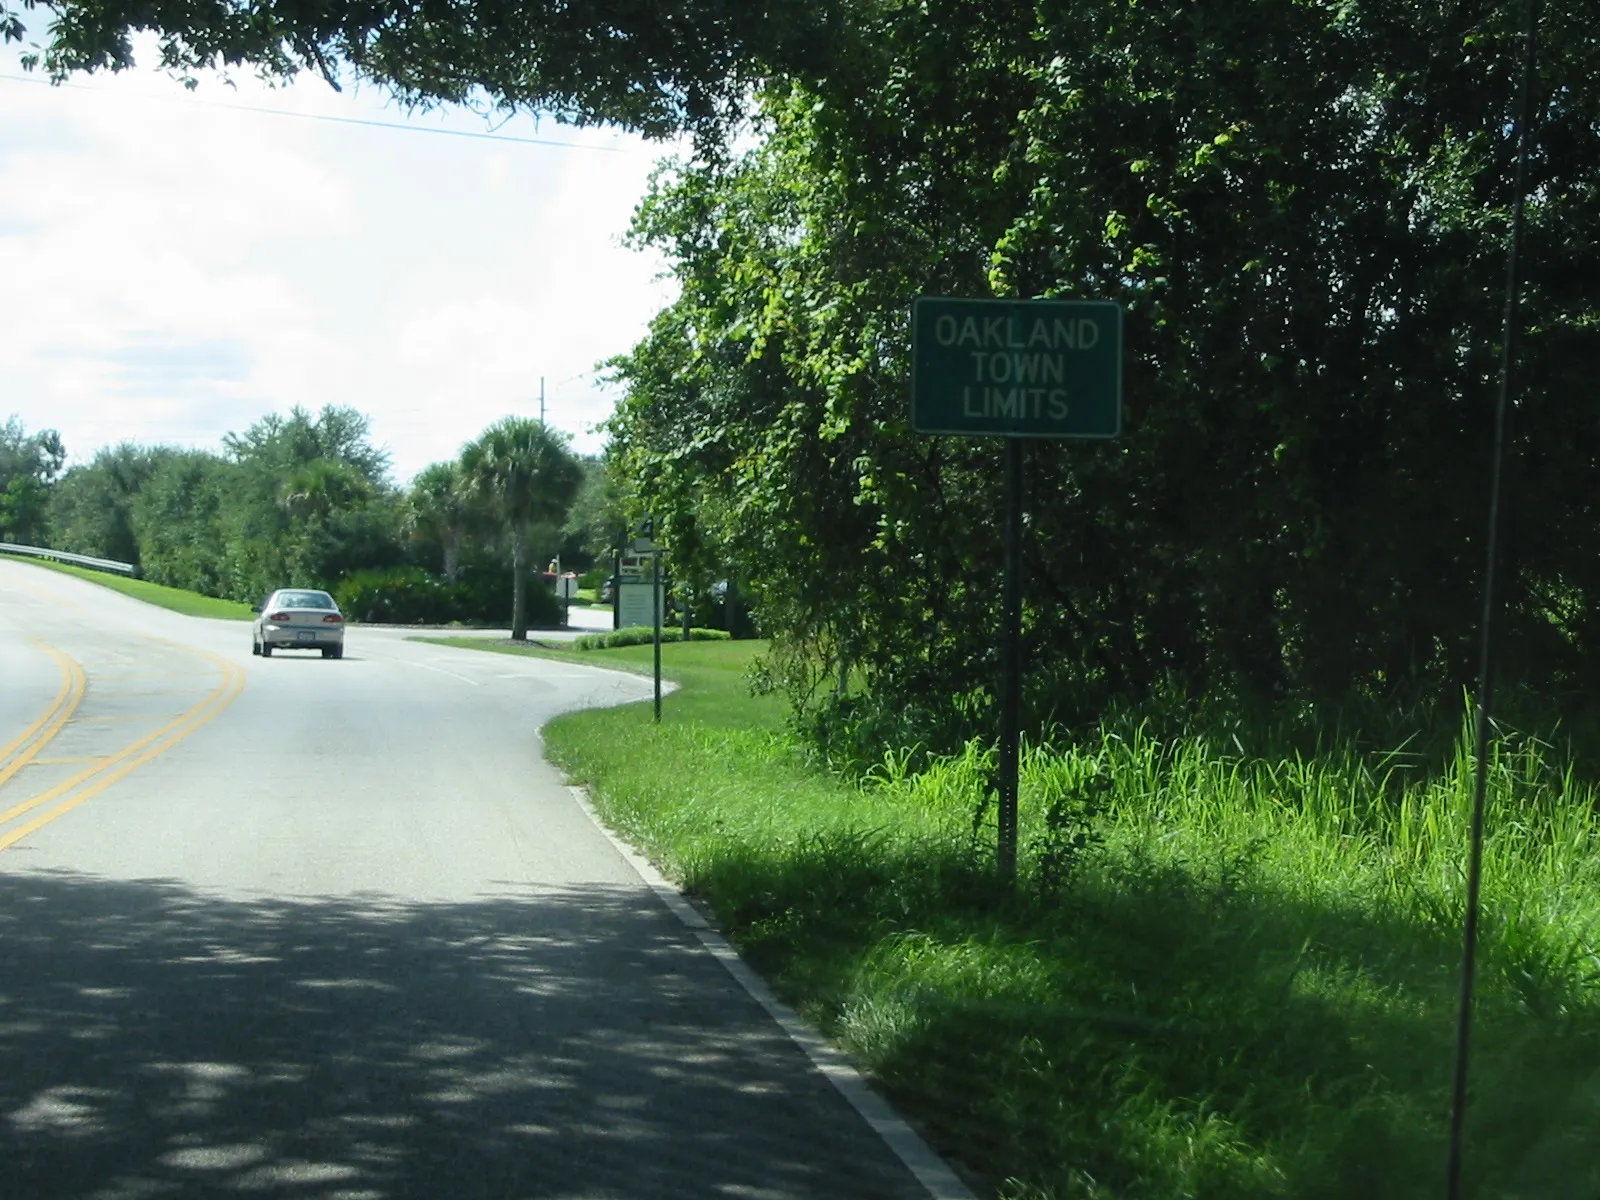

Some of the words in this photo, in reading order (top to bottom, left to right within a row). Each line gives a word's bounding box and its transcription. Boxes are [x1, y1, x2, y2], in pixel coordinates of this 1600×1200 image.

[935, 315, 1100, 350] OAKLAND
[970, 352, 1064, 384] TOWN
[964, 386, 1069, 420] LIMITS
